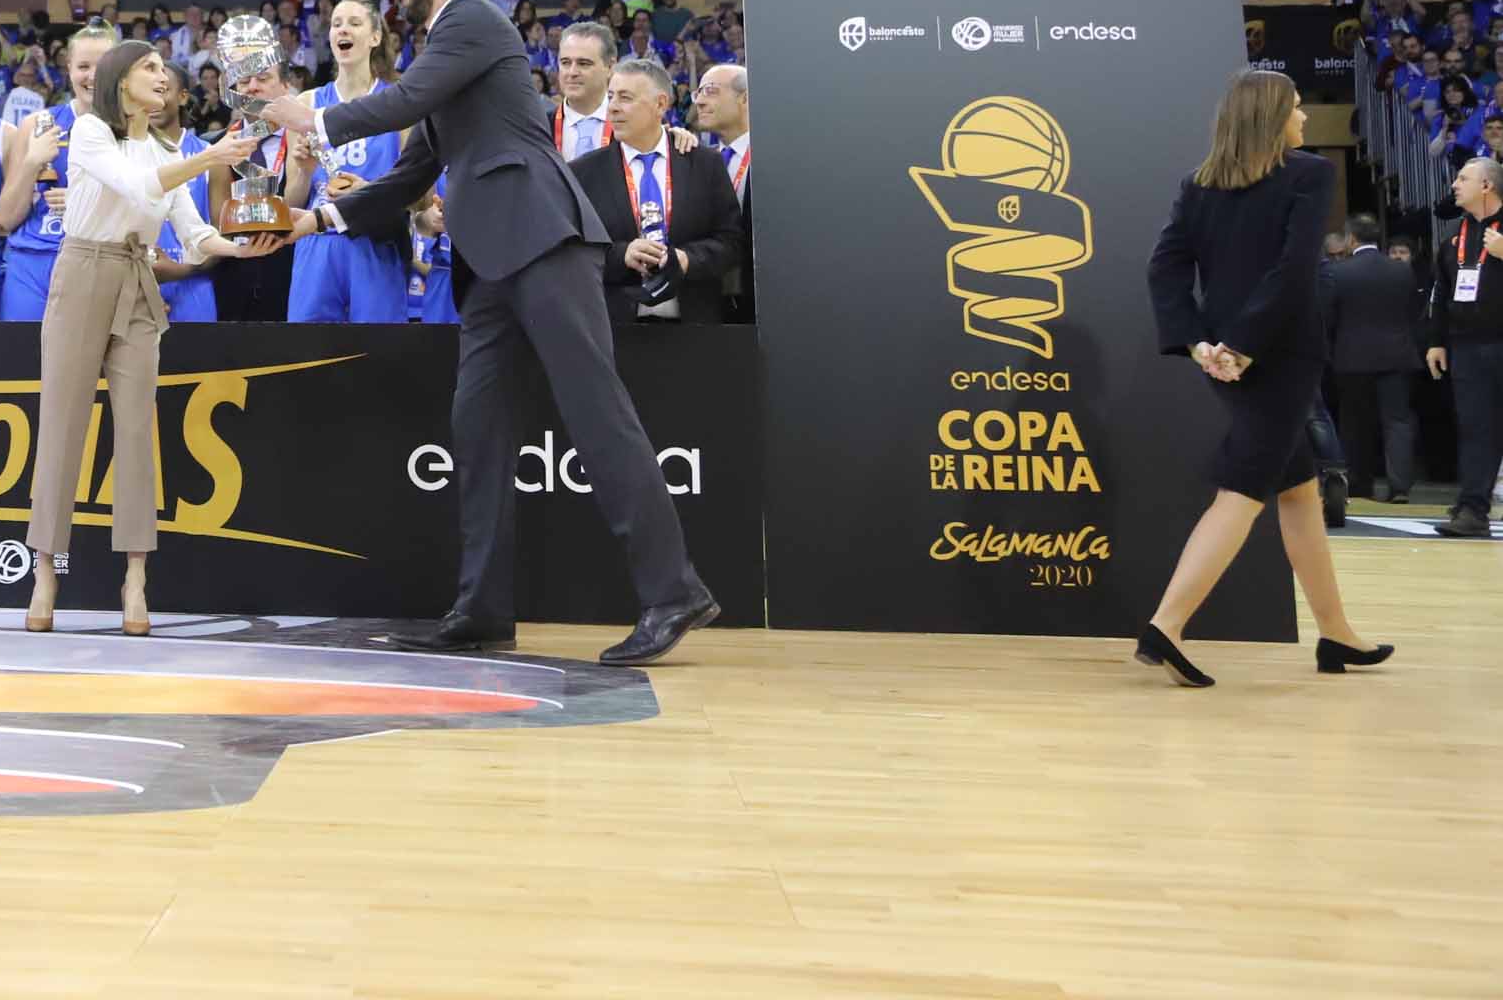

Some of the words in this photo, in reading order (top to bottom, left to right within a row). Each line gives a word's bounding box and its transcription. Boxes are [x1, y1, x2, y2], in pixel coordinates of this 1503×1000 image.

[869, 25, 925, 37] baloncesto
[1049, 22, 1137, 41] endesa
[951, 366, 1070, 391] endesa
[938, 410, 1085, 451] COPA
[407, 430, 701, 495] edea
[930, 454, 955, 470] DE
[963, 454, 1102, 492] REINA
[930, 471, 958, 490] LA
[1029, 564, 1093, 587] 2020
